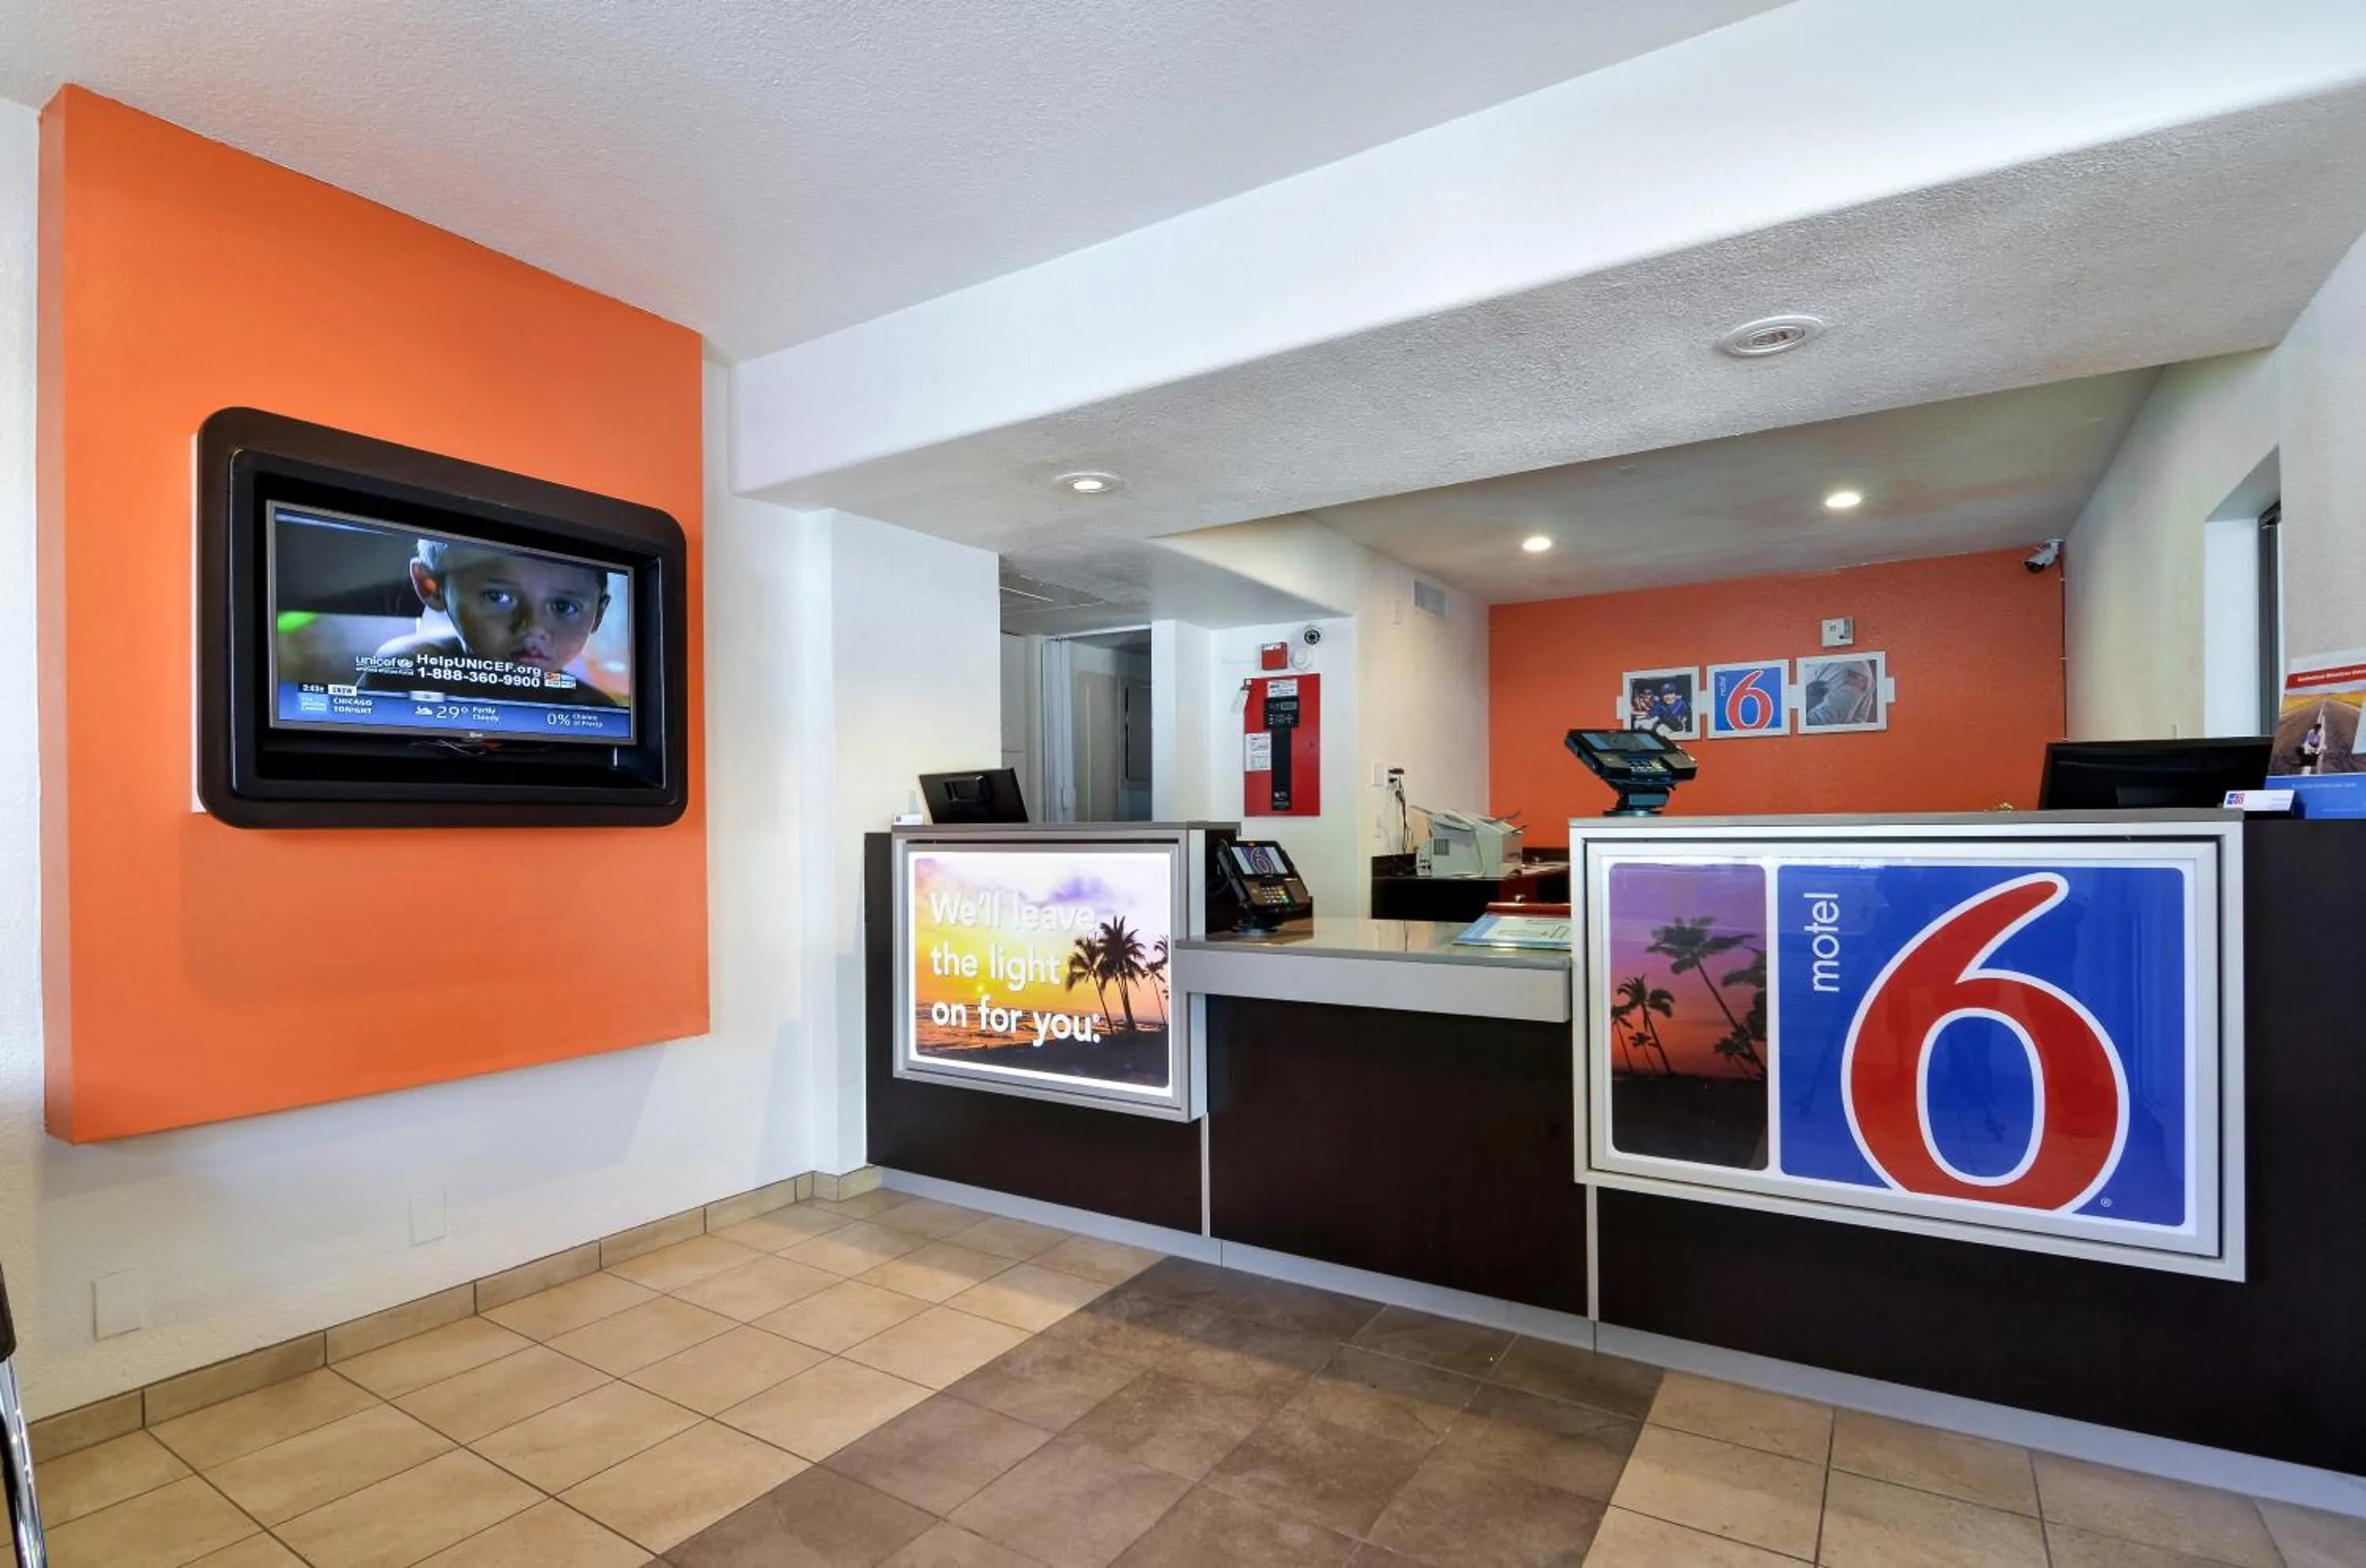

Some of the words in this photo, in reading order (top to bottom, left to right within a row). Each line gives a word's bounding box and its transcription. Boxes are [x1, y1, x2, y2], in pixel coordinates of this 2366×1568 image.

[417, 654, 541, 678] HelpUNICEF.org
[418, 666, 540, 687] 1-888-360-9900
[333, 696, 372, 706] CHICAGO
[1726, 670, 1774, 730] 6
[1014, 888, 1096, 932] leave
[930, 939, 980, 978] the
[989, 943, 1062, 991] light
[931, 1001, 967, 1029] on
[978, 994, 1023, 1034] for
[1803, 892, 1841, 992] motel
[1841, 872, 2130, 1215] 6
